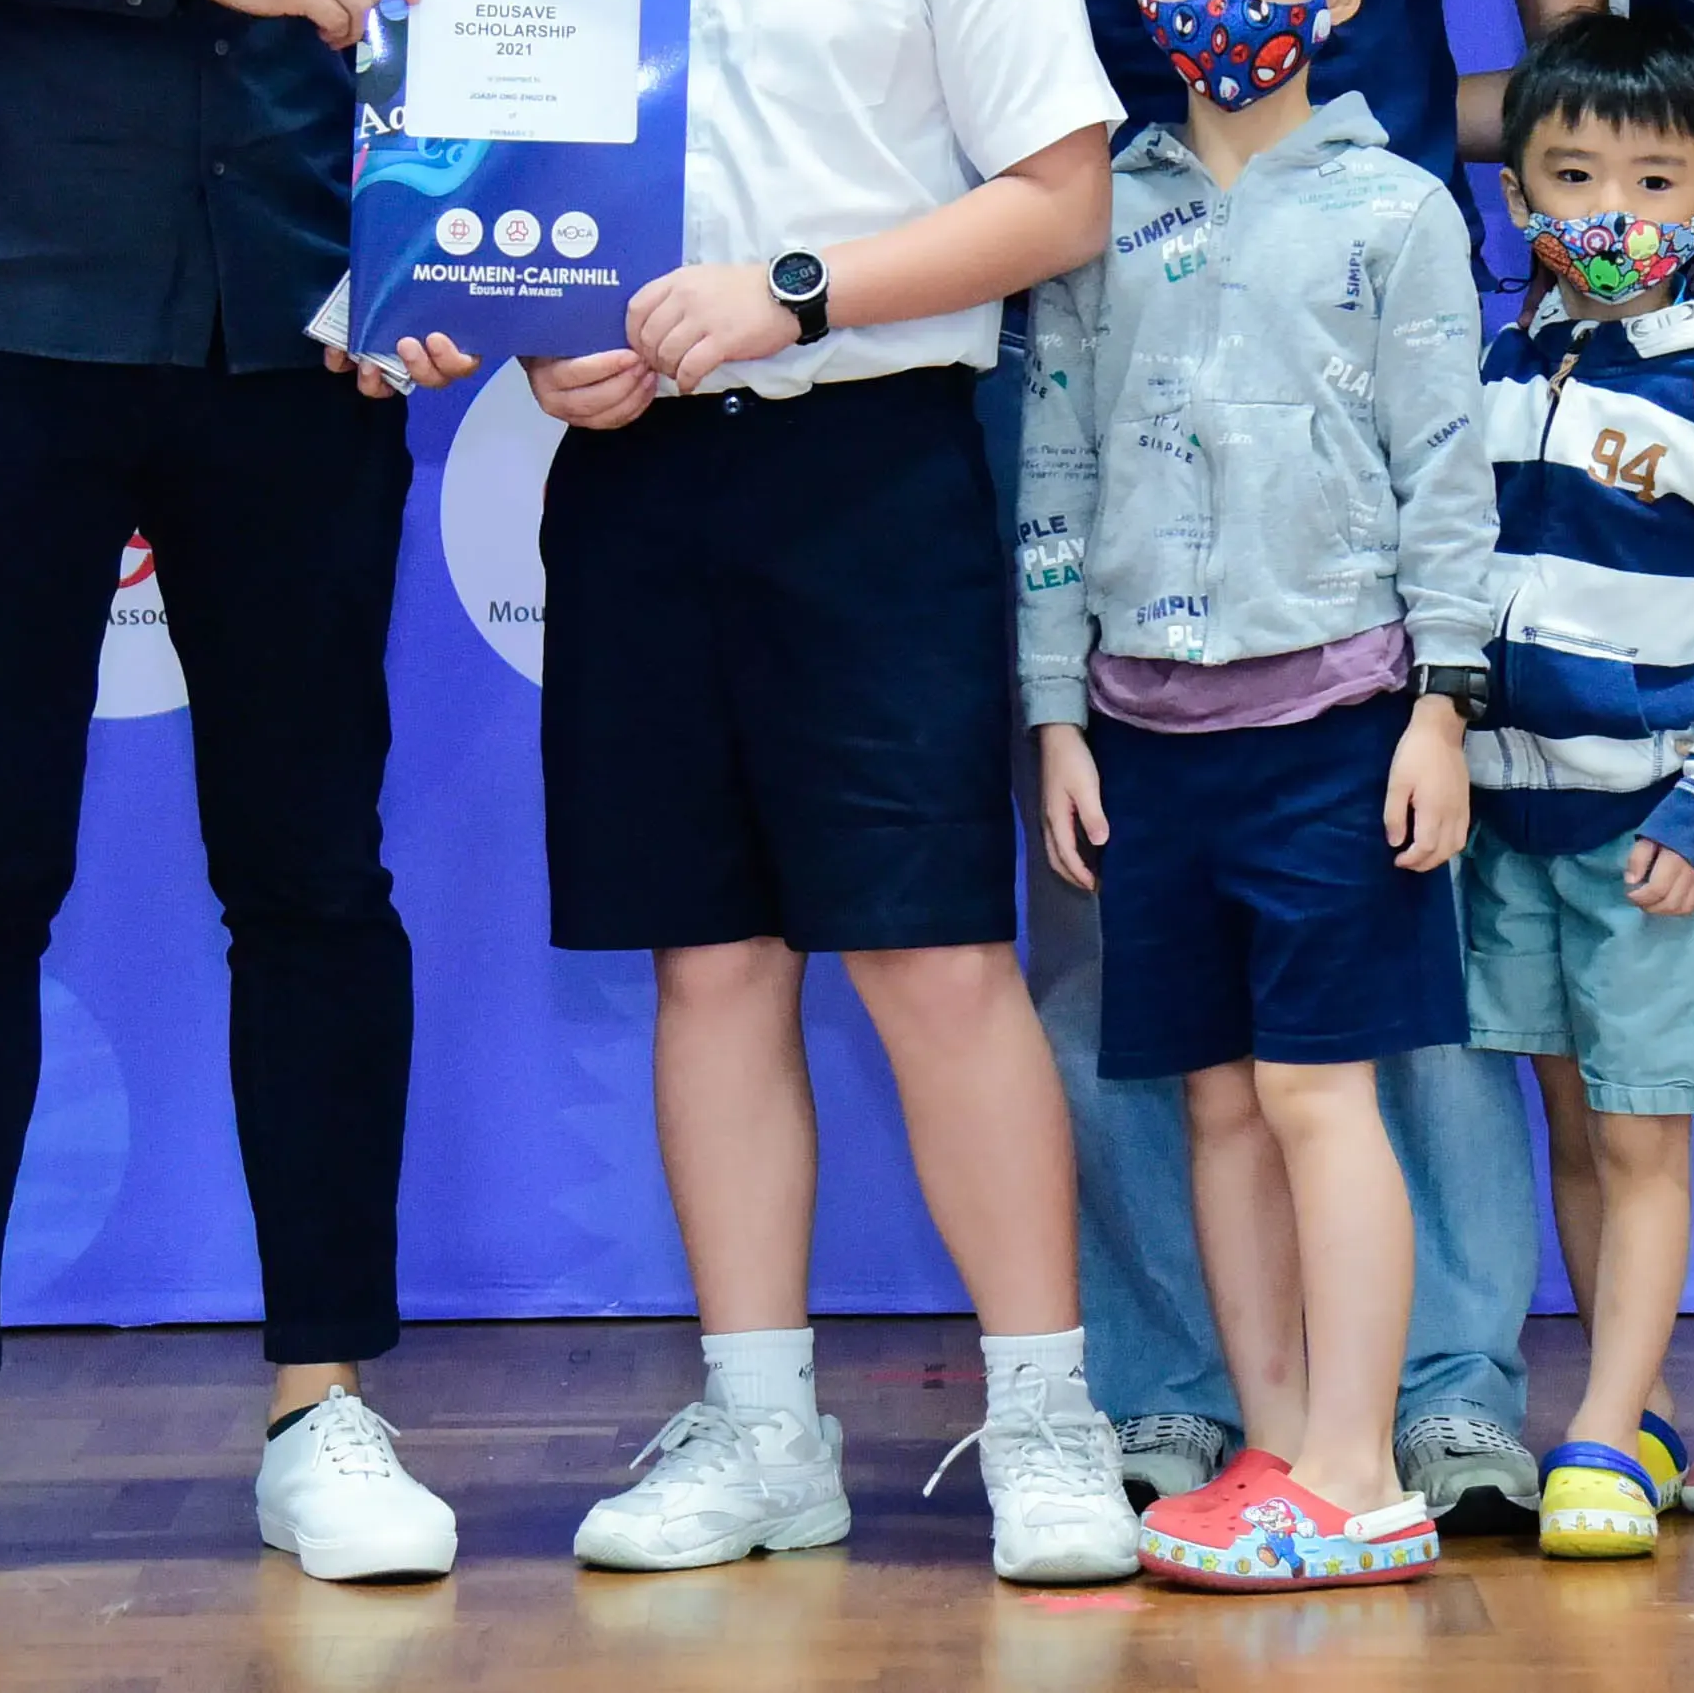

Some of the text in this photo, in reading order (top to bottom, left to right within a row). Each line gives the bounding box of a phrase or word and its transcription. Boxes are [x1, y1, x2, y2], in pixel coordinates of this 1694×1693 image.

[475, 3, 558, 20] EDUSAVE
[454, 21, 577, 39] SCHOLARSHIP
[496, 42, 533, 56] 2021
[1115, 199, 1207, 254] SIMPLE
[413, 263, 620, 287] MOULMEIN-CAIRNHILL
[1164, 254, 1208, 283] LEA
[1346, 239, 1366, 298] SIMPLE
[1426, 413, 1471, 449] LEARN
[1588, 427, 1668, 504] 94
